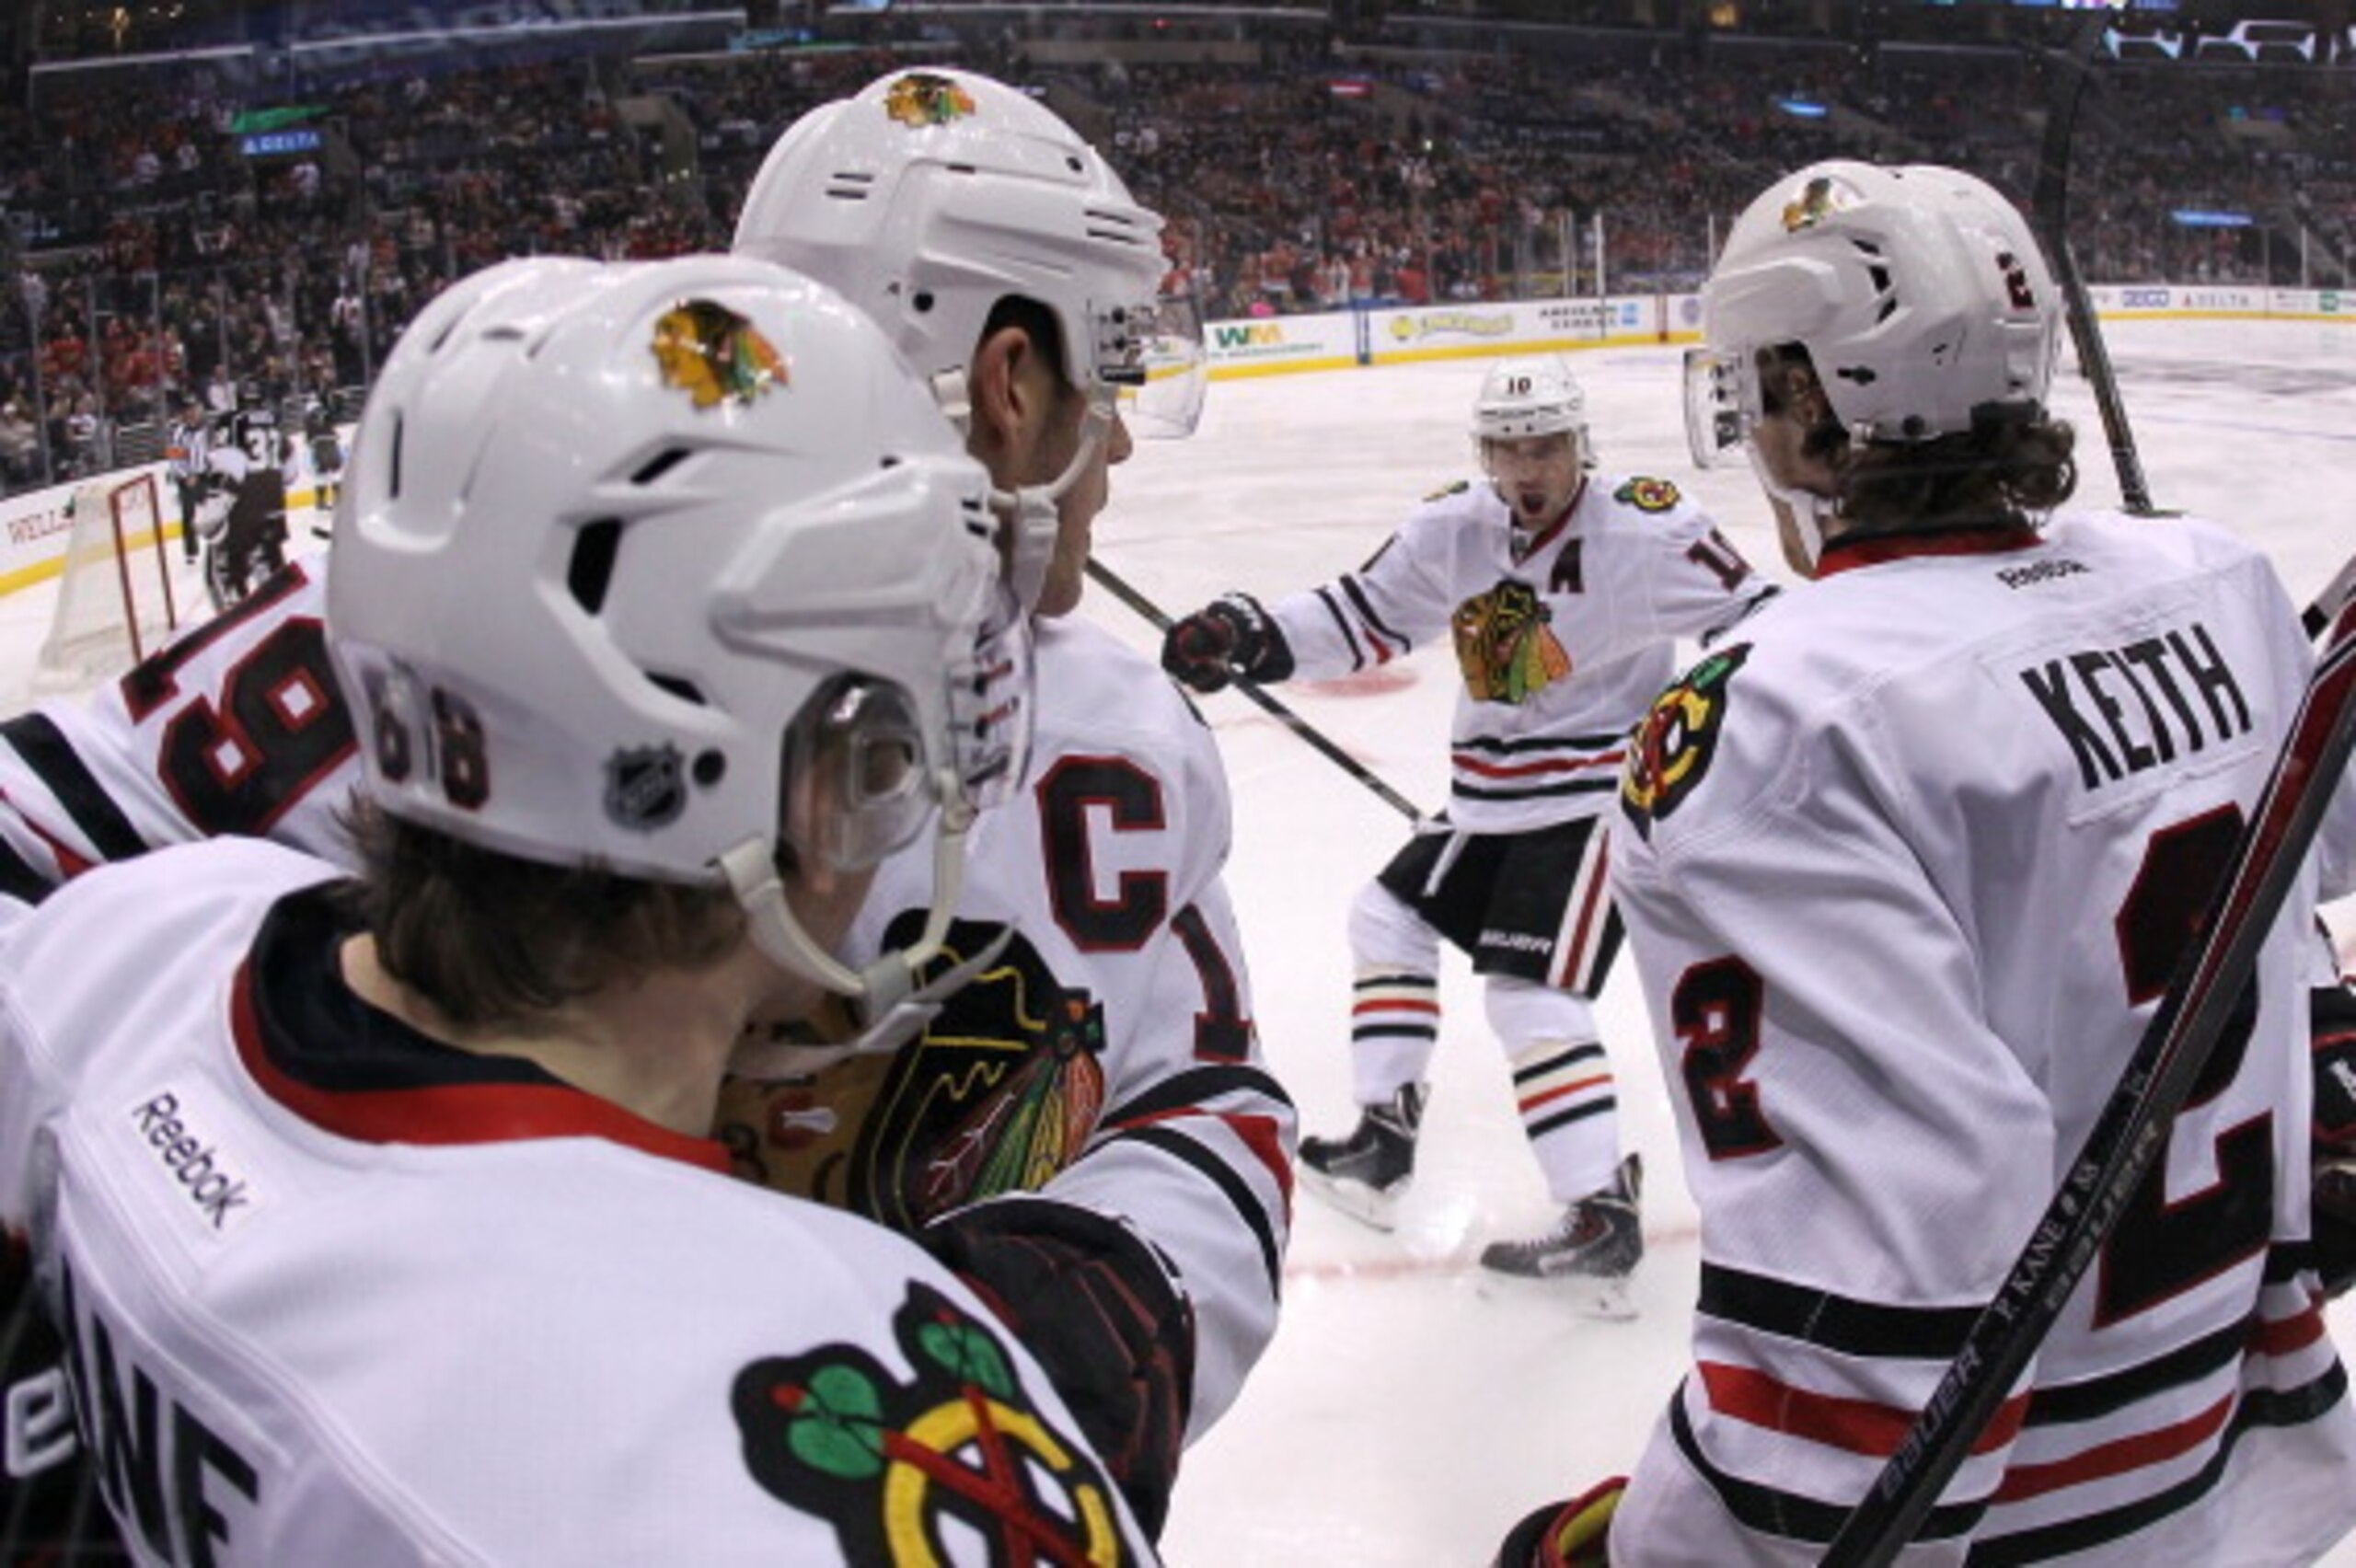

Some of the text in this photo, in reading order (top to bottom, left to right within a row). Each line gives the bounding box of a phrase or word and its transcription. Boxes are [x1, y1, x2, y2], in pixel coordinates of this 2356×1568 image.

[1507, 375, 1531, 395] 10
[1548, 536, 1585, 594] A
[2020, 623, 2252, 791] KEITH
[1035, 755, 1168, 952] C
[1671, 953, 1784, 1161] 2
[2091, 801, 2273, 1331] 2
[133, 1092, 248, 1229] Reebok
[2010, 1217, 2067, 1296] KANE
